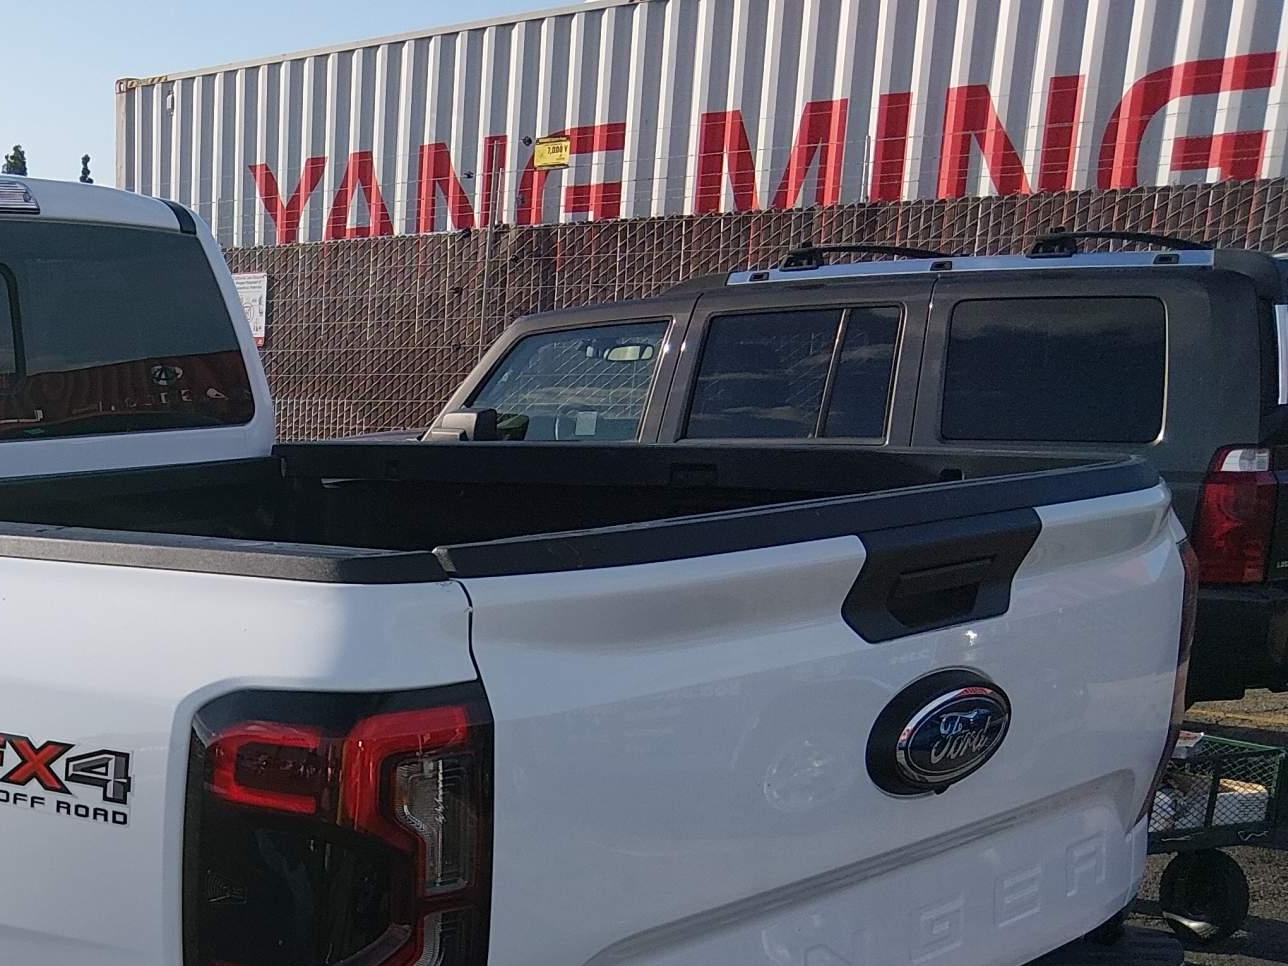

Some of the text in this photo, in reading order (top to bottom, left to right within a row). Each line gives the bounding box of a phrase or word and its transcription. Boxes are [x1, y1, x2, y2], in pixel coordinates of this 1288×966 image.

[248, 51, 1280, 245] YANG MING
[930, 707, 992, 765] Ford
[56, 800, 128, 826] ROAD
